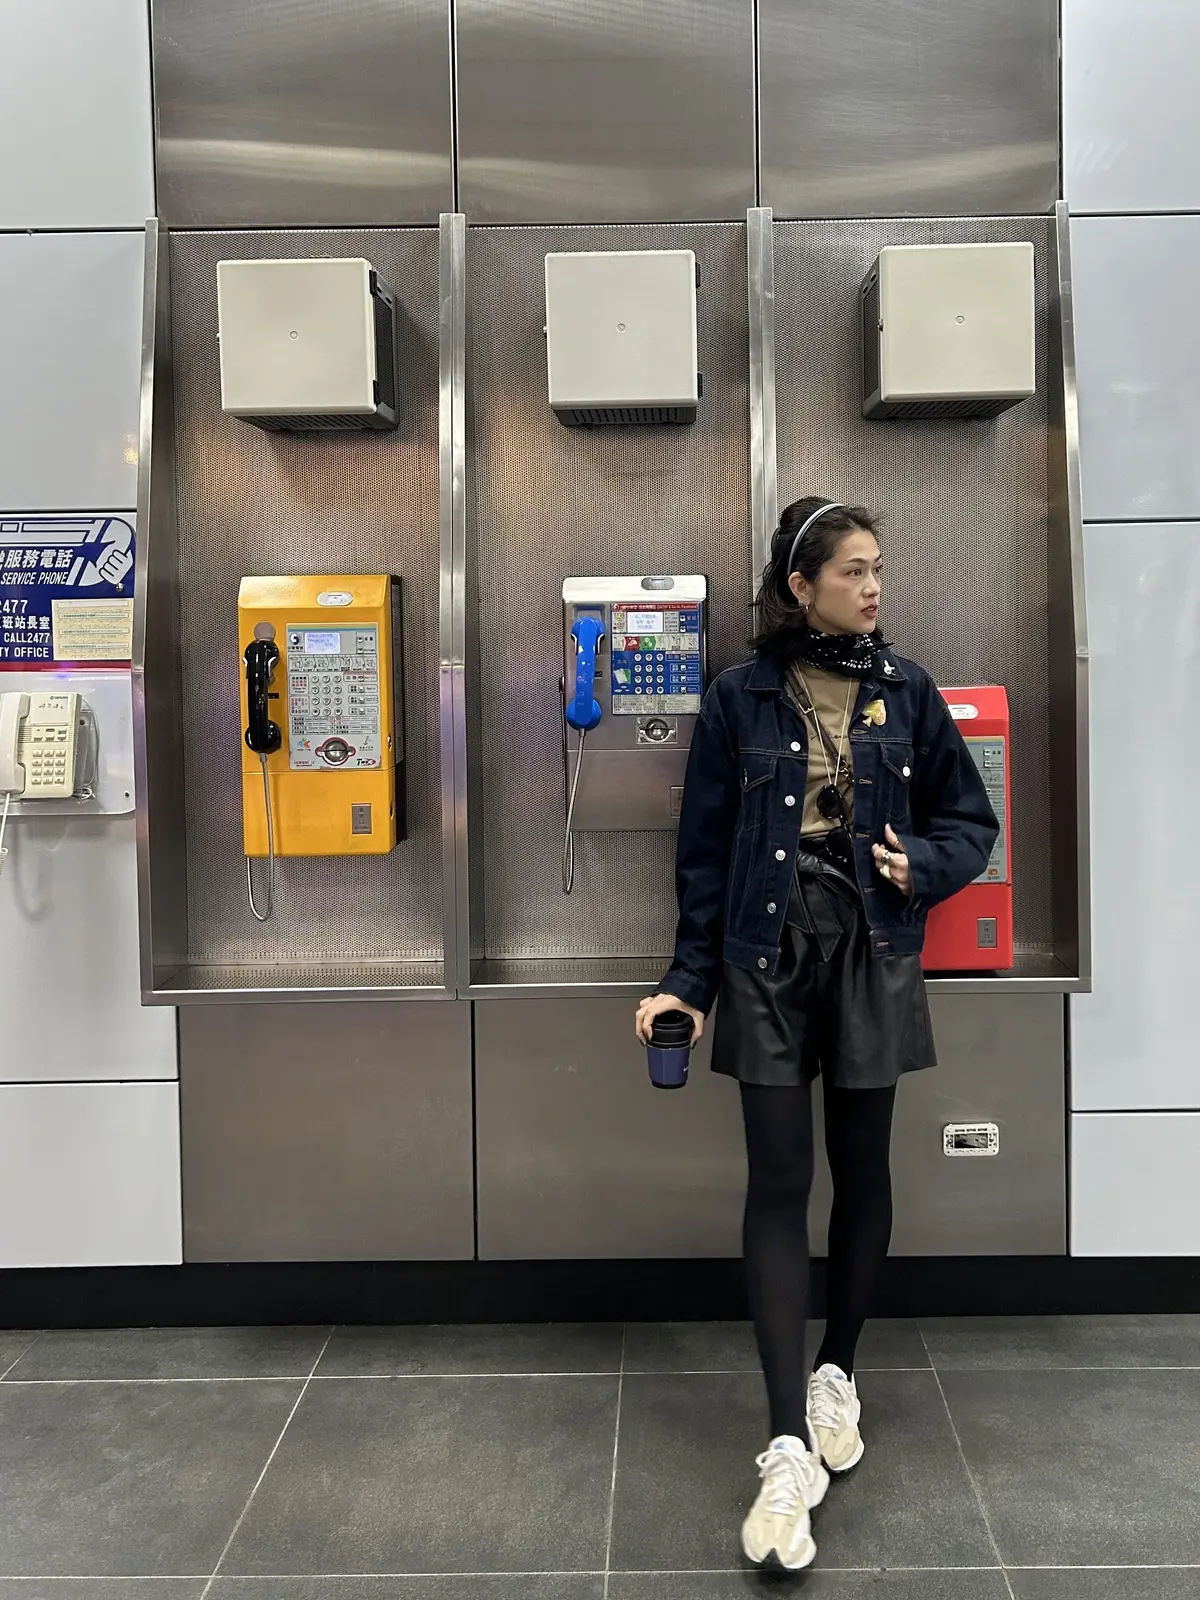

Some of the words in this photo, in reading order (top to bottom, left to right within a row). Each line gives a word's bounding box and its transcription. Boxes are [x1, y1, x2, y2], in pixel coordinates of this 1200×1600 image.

[0, 571, 37, 585] SERVICE
[38, 571, 69, 585] PHONE
[0, 599, 28, 613] 477
[0, 615, 50, 630] 班站長室
[3, 632, 50, 643] CALL2477
[14, 646, 49, 658] OFFICE
